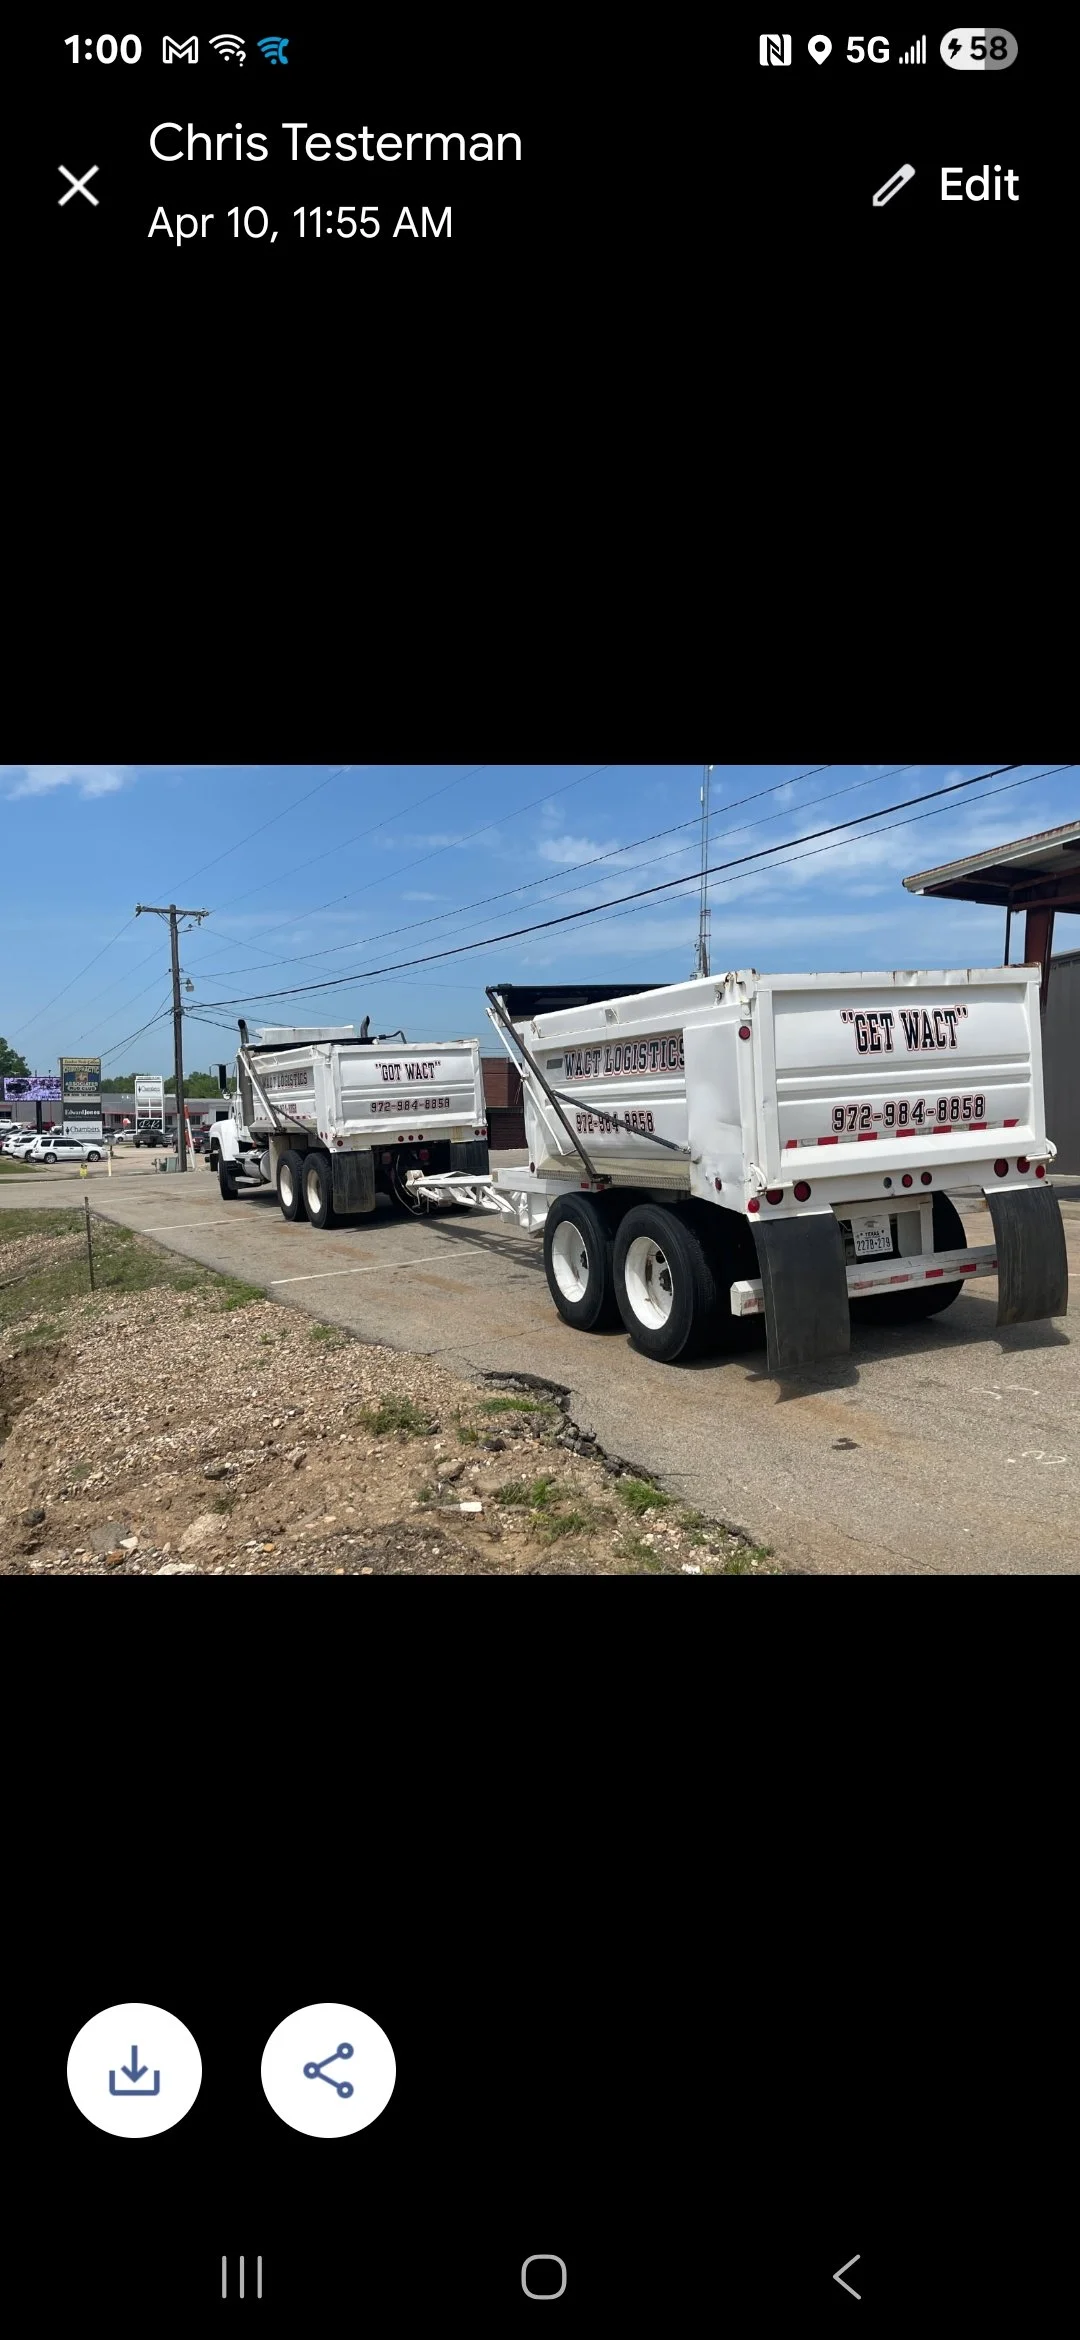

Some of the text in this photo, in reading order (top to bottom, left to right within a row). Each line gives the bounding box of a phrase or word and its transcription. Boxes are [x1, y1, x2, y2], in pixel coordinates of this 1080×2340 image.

[564, 1048, 602, 1078] WACT
[371, 1097, 450, 1112] 972-984-8858
[832, 1094, 985, 1132] 972-984-8858
